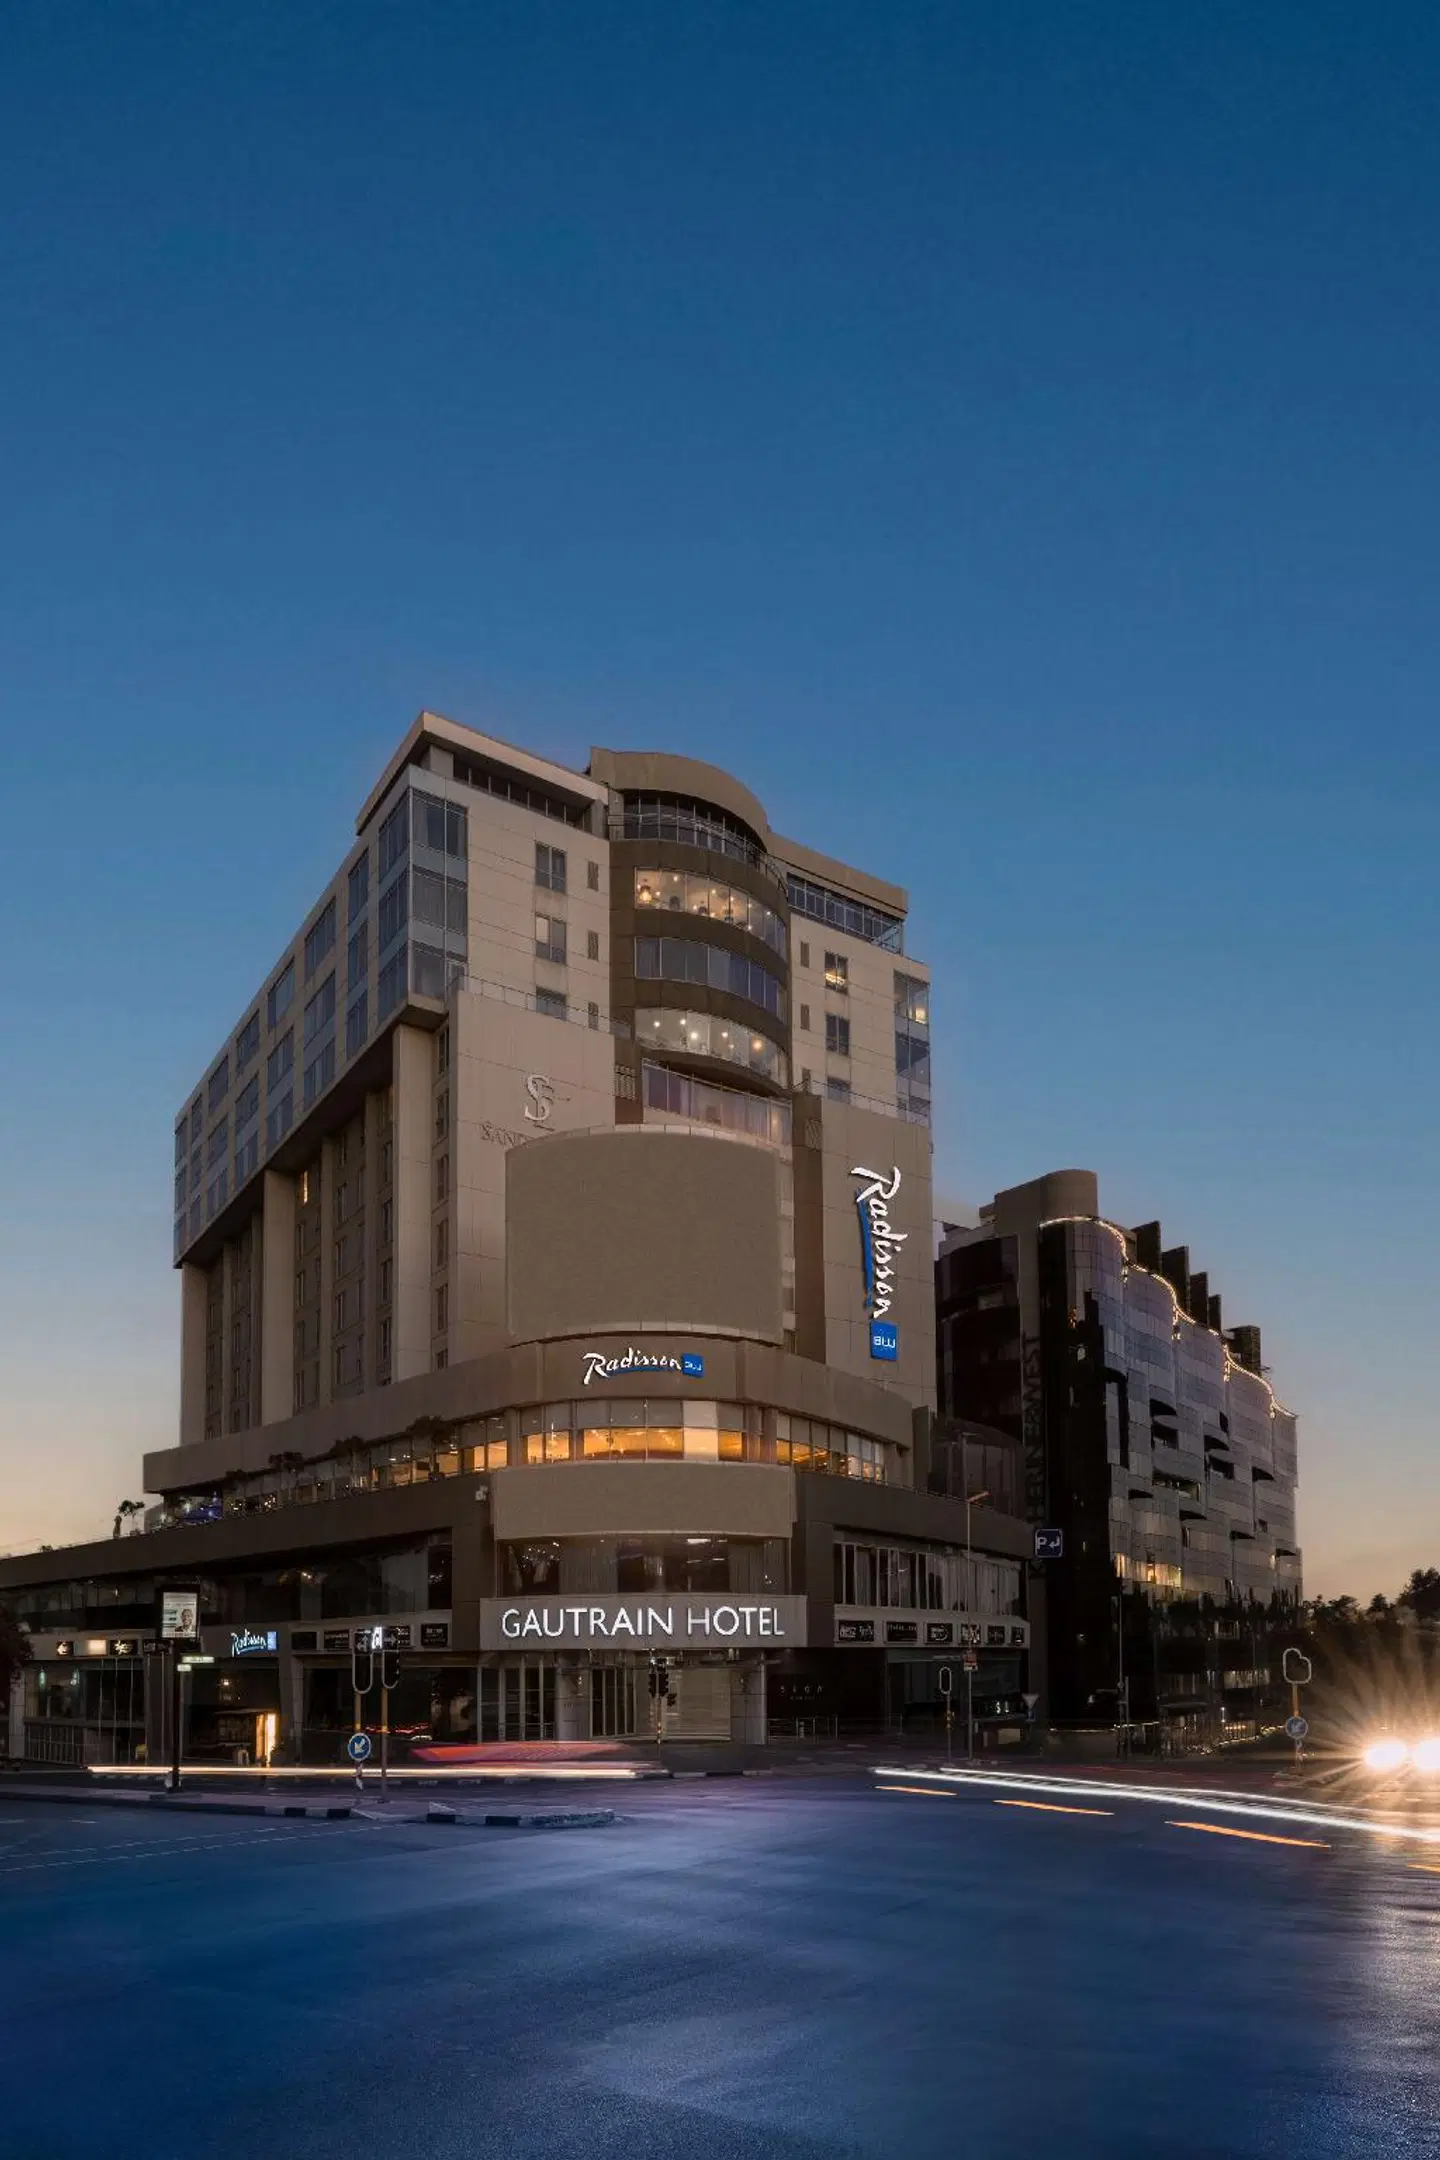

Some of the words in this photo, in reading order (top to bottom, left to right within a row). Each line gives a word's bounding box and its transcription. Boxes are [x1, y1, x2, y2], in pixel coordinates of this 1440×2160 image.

[850, 1166, 909, 1319] Radisson
[582, 1347, 682, 1385] Radisson
[1037, 1536, 1048, 1550] P
[501, 1606, 674, 1638] GAUTRAIN
[687, 1606, 786, 1636] HOTEL
